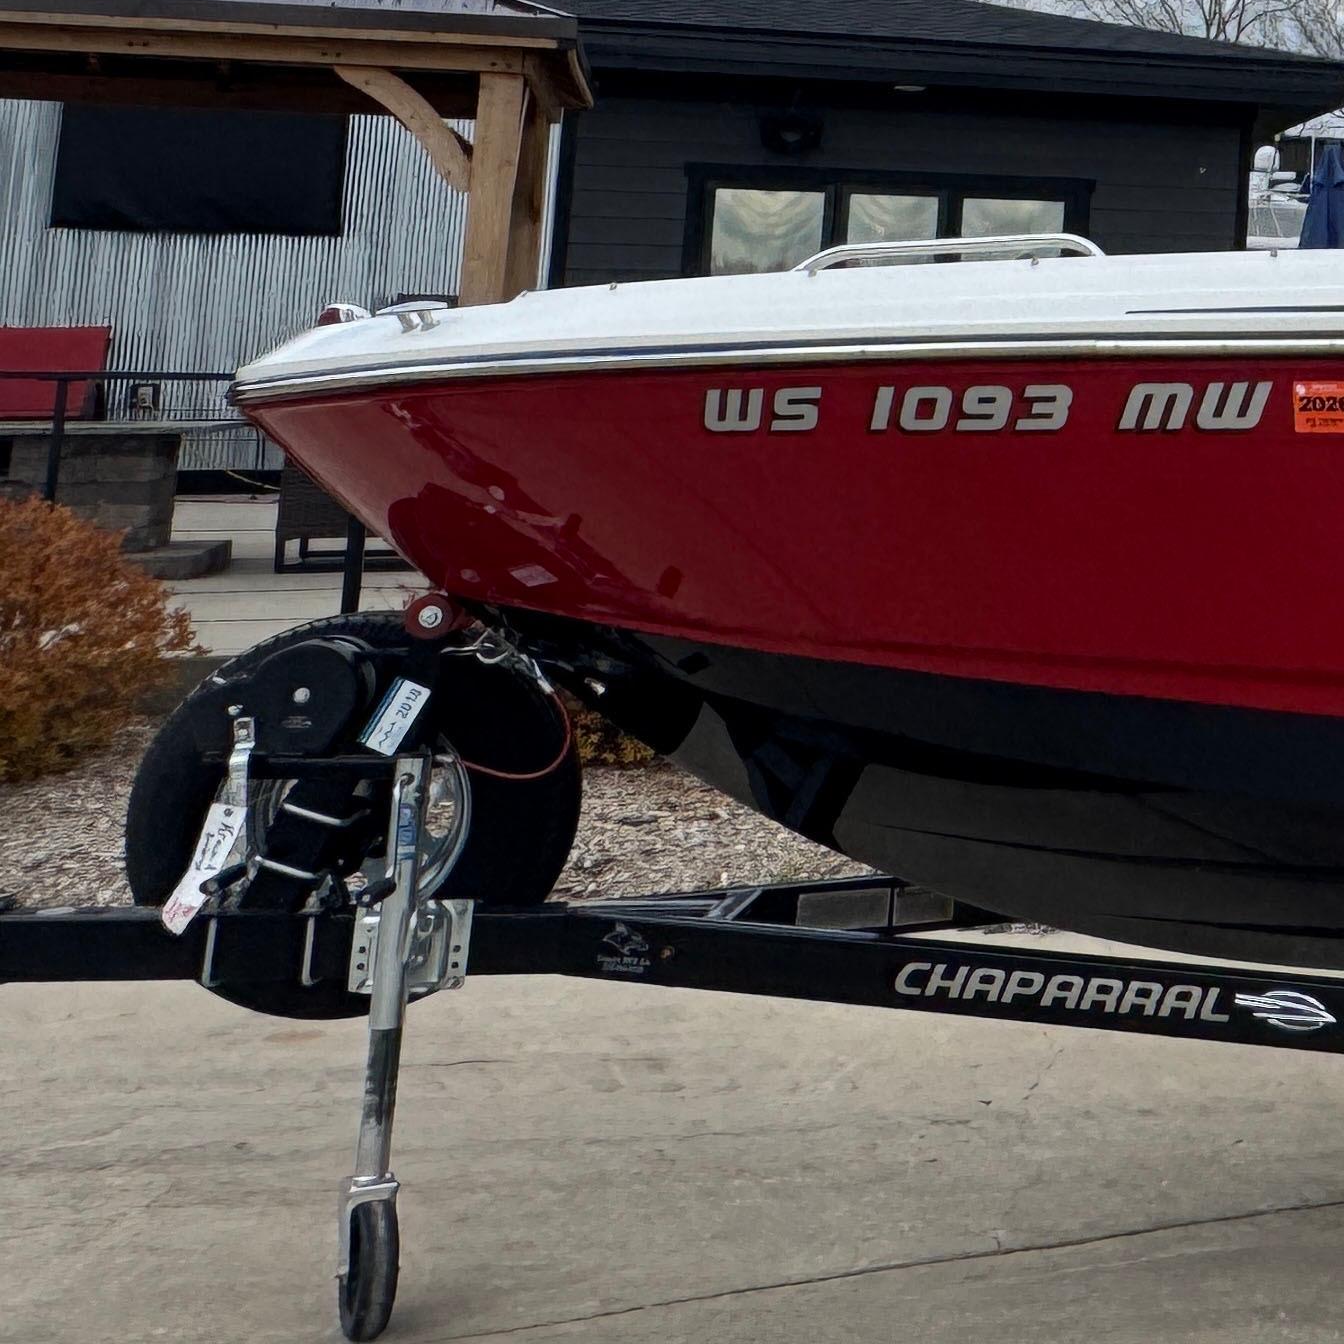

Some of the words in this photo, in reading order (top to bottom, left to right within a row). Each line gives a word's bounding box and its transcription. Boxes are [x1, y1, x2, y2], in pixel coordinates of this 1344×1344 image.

[703, 387, 822, 432] WS
[870, 384, 1073, 432] 1093
[1118, 381, 1274, 431] MW
[894, 961, 1231, 1023] CHAPARRAL
